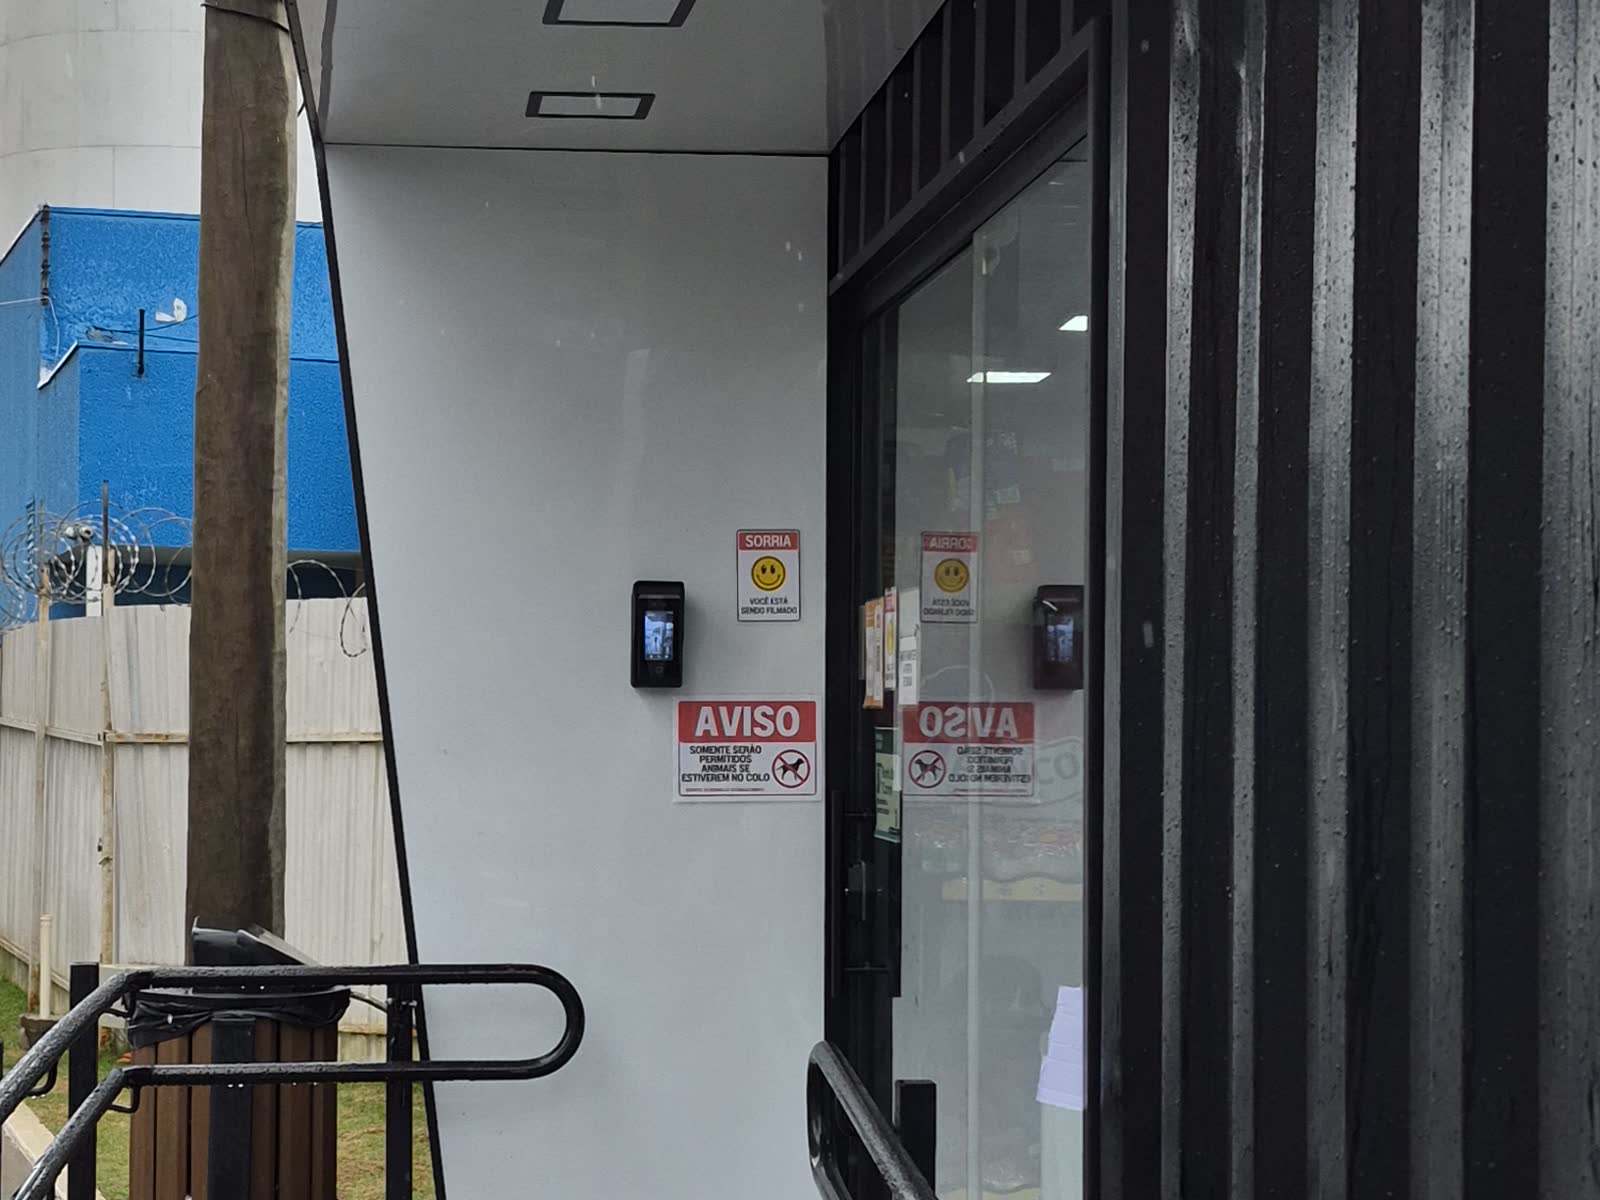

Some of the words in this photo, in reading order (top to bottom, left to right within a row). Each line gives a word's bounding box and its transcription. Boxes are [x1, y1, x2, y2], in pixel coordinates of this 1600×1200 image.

[745, 535, 791, 548] SORRIA
[750, 596, 769, 605] VOCÊ
[770, 596, 788, 605] ESTÁ
[741, 606, 765, 614] SENDO
[766, 606, 797, 614] FILMADO
[694, 705, 800, 737] AVISO
[689, 746, 731, 754] SOMENTE
[733, 744, 762, 754] SERÃO
[699, 755, 752, 763] PERMITIDOS
[701, 764, 737, 772] ANIMAIS
[739, 764, 750, 772] SE
[681, 774, 729, 782] ESTIVEREM
[731, 774, 744, 782] NO
[746, 774, 770, 782] COLO
